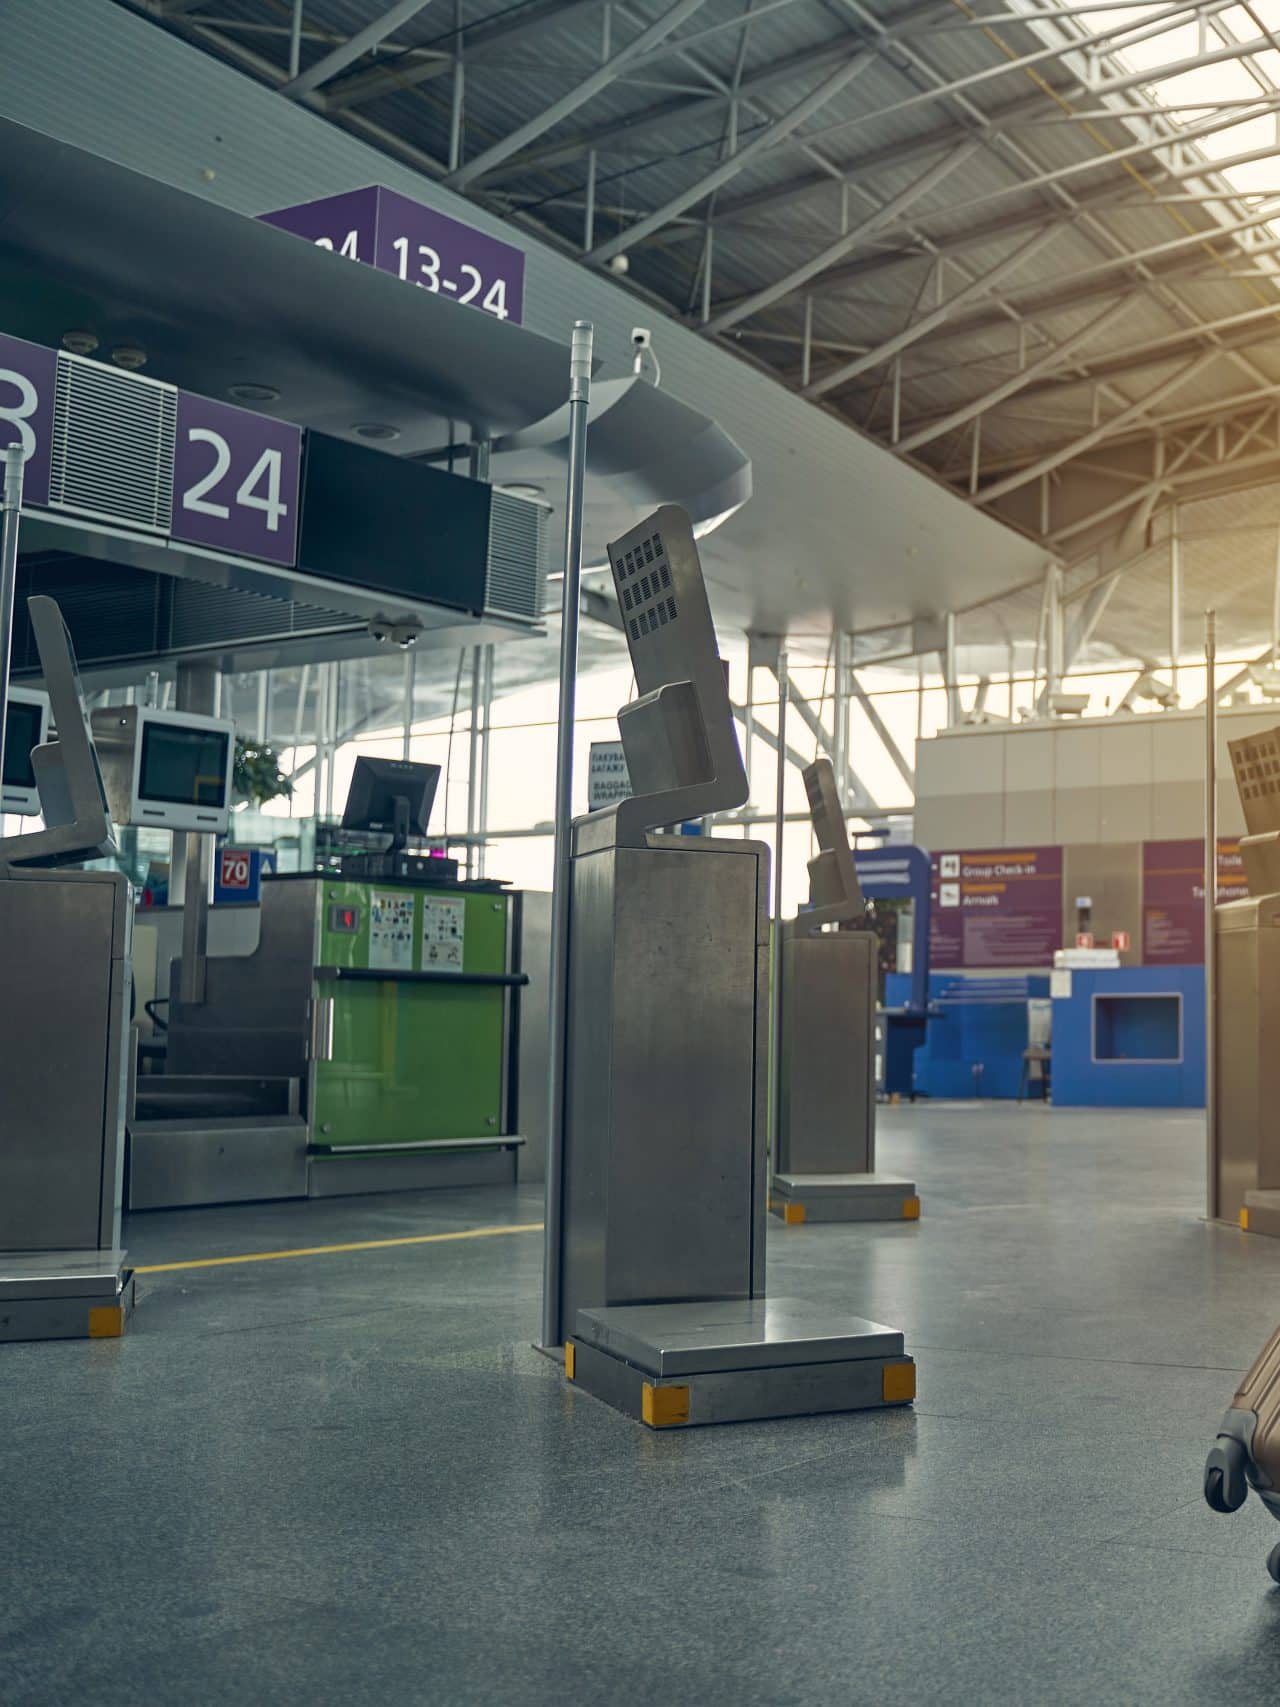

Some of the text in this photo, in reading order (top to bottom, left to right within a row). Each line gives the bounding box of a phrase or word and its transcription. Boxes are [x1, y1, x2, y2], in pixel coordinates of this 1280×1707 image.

[392, 236, 509, 320] 13-24
[182, 428, 287, 531] 24
[224, 860, 248, 881] 70
[962, 866, 993, 878] Group
[962, 895, 999, 906] Arrivals
